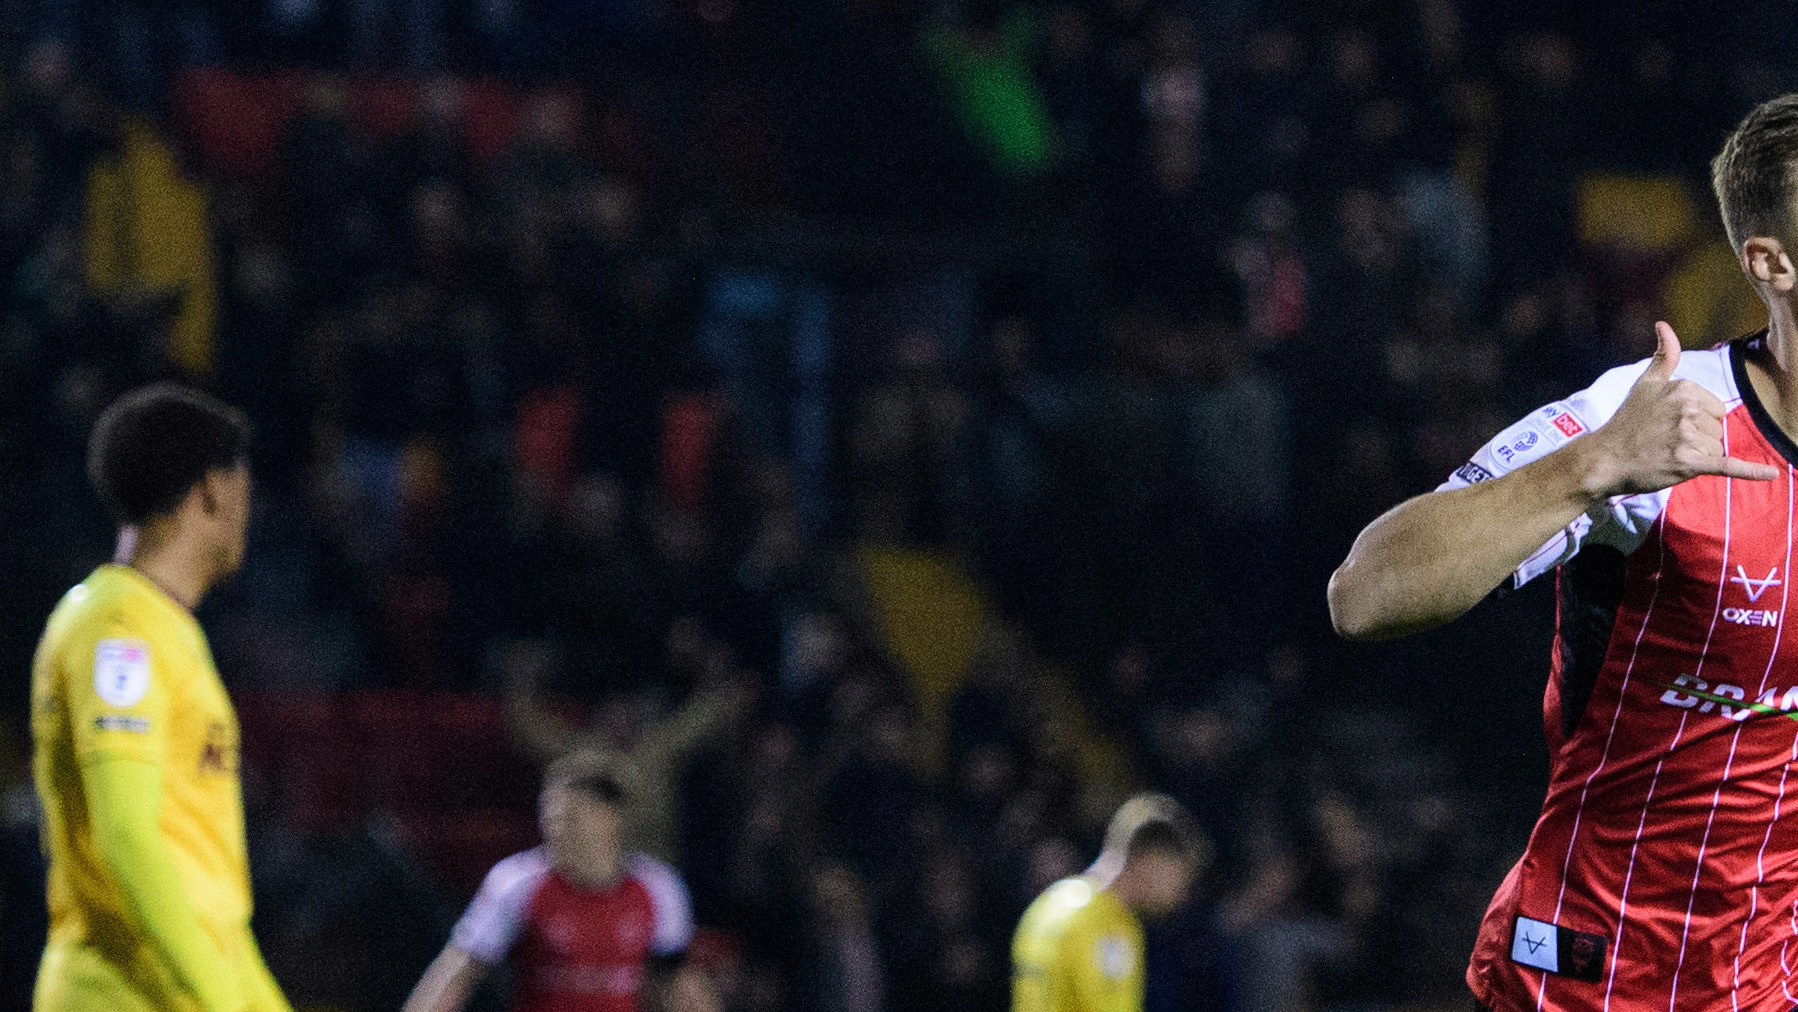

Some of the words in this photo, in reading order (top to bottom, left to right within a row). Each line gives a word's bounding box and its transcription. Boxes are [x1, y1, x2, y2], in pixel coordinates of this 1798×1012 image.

[1554, 413, 1580, 436] bet
[1497, 444, 1516, 463] EFL
[1722, 607, 1779, 627] OXEN
